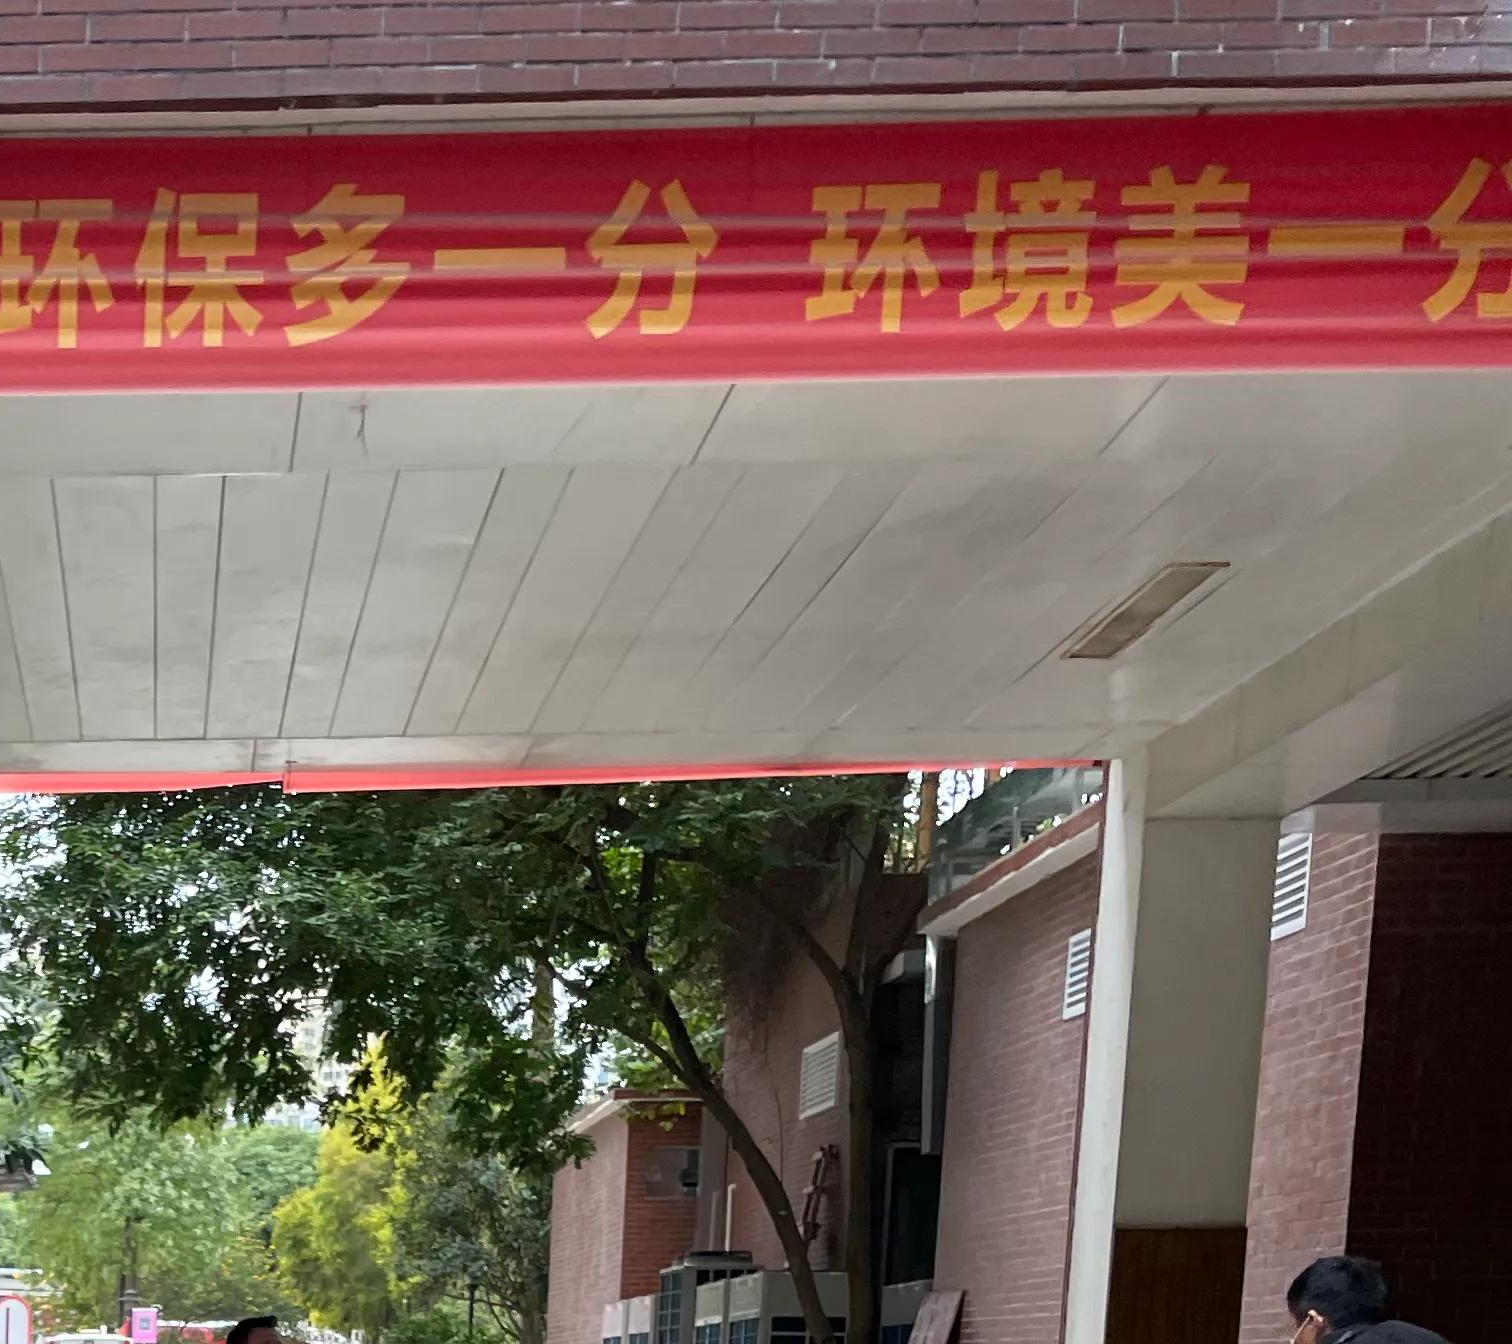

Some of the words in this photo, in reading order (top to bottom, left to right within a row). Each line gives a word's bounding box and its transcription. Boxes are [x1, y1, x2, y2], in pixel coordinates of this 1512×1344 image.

[803, 157, 1512, 334] 环境美一分
